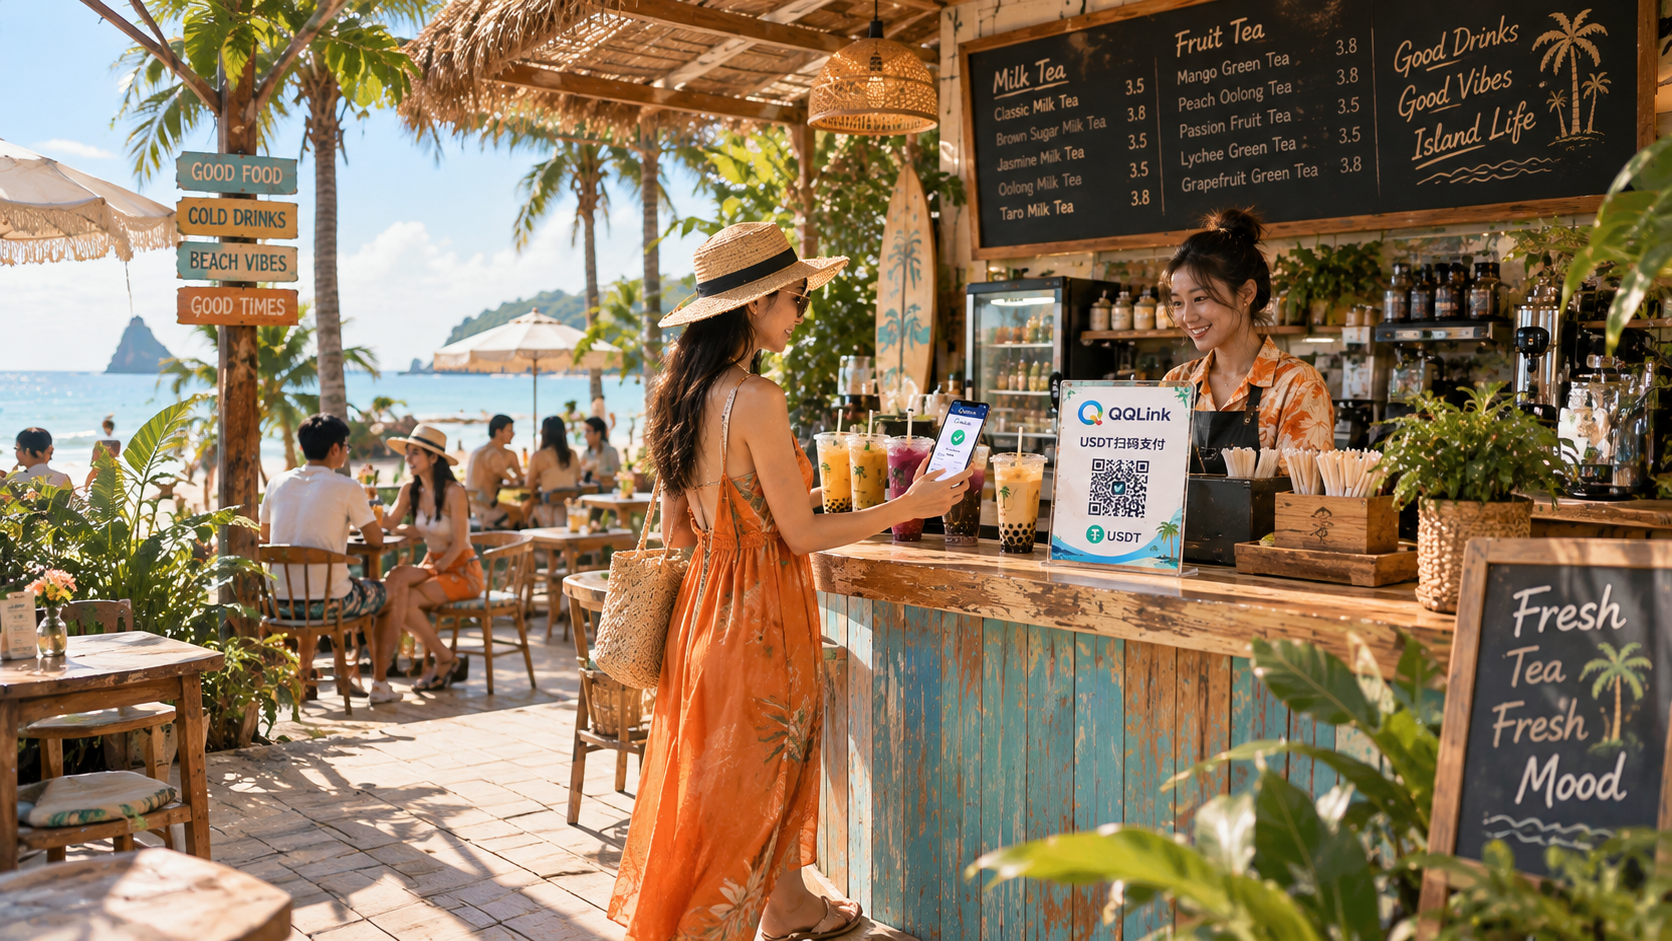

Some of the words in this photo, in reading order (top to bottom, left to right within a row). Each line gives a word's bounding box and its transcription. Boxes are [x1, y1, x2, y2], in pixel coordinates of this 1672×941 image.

[1175, 26, 1223, 57] Fruit
[1230, 17, 1265, 44] Tea
[1336, 38, 1357, 55] 3.8
[1394, 31, 1447, 78] Good
[1453, 15, 1519, 57] Drinks
[993, 64, 1030, 93] Milk
[1035, 58, 1066, 83] Tea
[1178, 68, 1217, 85] Mango
[1222, 60, 1260, 76] Green
[1265, 52, 1289, 67] Tea
[1337, 67, 1358, 85] 3.8
[1125, 78, 1144, 95] 3.5
[1178, 93, 1215, 112] Peach
[1220, 87, 1263, 104] Oolong
[1268, 80, 1292, 95] Tea
[1398, 75, 1451, 122] Good
[1457, 65, 1512, 99] Vibes
[994, 103, 1029, 121] Classic
[1033, 97, 1055, 114] Milk
[1059, 94, 1078, 109] Tea
[1127, 105, 1146, 122] 3.8
[1338, 97, 1360, 114] 3.5
[996, 131, 1027, 146] Brown
[1030, 126, 1059, 142] Sugar
[1062, 119, 1084, 135] Milk
[1087, 116, 1107, 130] Tea
[1180, 121, 1225, 138] Passion
[1230, 113, 1261, 131] Fruit
[1267, 109, 1291, 124] Tea
[1412, 112, 1481, 161] Island
[1489, 101, 1536, 144] Life
[1128, 133, 1147, 150] 3.5
[1339, 126, 1360, 144] 3.5
[997, 155, 1037, 171] Jasmine
[1040, 149, 1061, 164] Milk
[1064, 146, 1085, 160] Tea
[1181, 148, 1224, 169] Lychee
[1229, 142, 1267, 159] Green
[1272, 136, 1296, 152] Tea
[192, 162, 235, 181] GOOD
[242, 165, 282, 184] FOOD
[1130, 161, 1148, 178] 3.5
[1340, 156, 1361, 173] 3.8
[998, 181, 1033, 196] Oolong
[1037, 176, 1058, 191] Milk
[1182, 172, 1246, 194] Grapefruit
[1251, 168, 1289, 184] Green
[1294, 163, 1318, 178] Tea
[1131, 189, 1150, 206] 3.8
[189, 207, 227, 225] COLD
[233, 209, 286, 228] DRINKS
[1000, 207, 1023, 220] Taro
[1028, 202, 1050, 217] Milk
[1054, 200, 1074, 214] Tea
[190, 251, 238, 270] BEACH
[245, 254, 286, 272] VIBES
[191, 296, 233, 317] GOOD
[1109, 407, 1171, 421] QQLink
[1107, 531, 1141, 543] USDT
[1513, 584, 1626, 638] Fresh
[1507, 645, 1566, 687] Tea
[1492, 698, 1588, 748] Fresh
[1515, 751, 1627, 809] Mood
